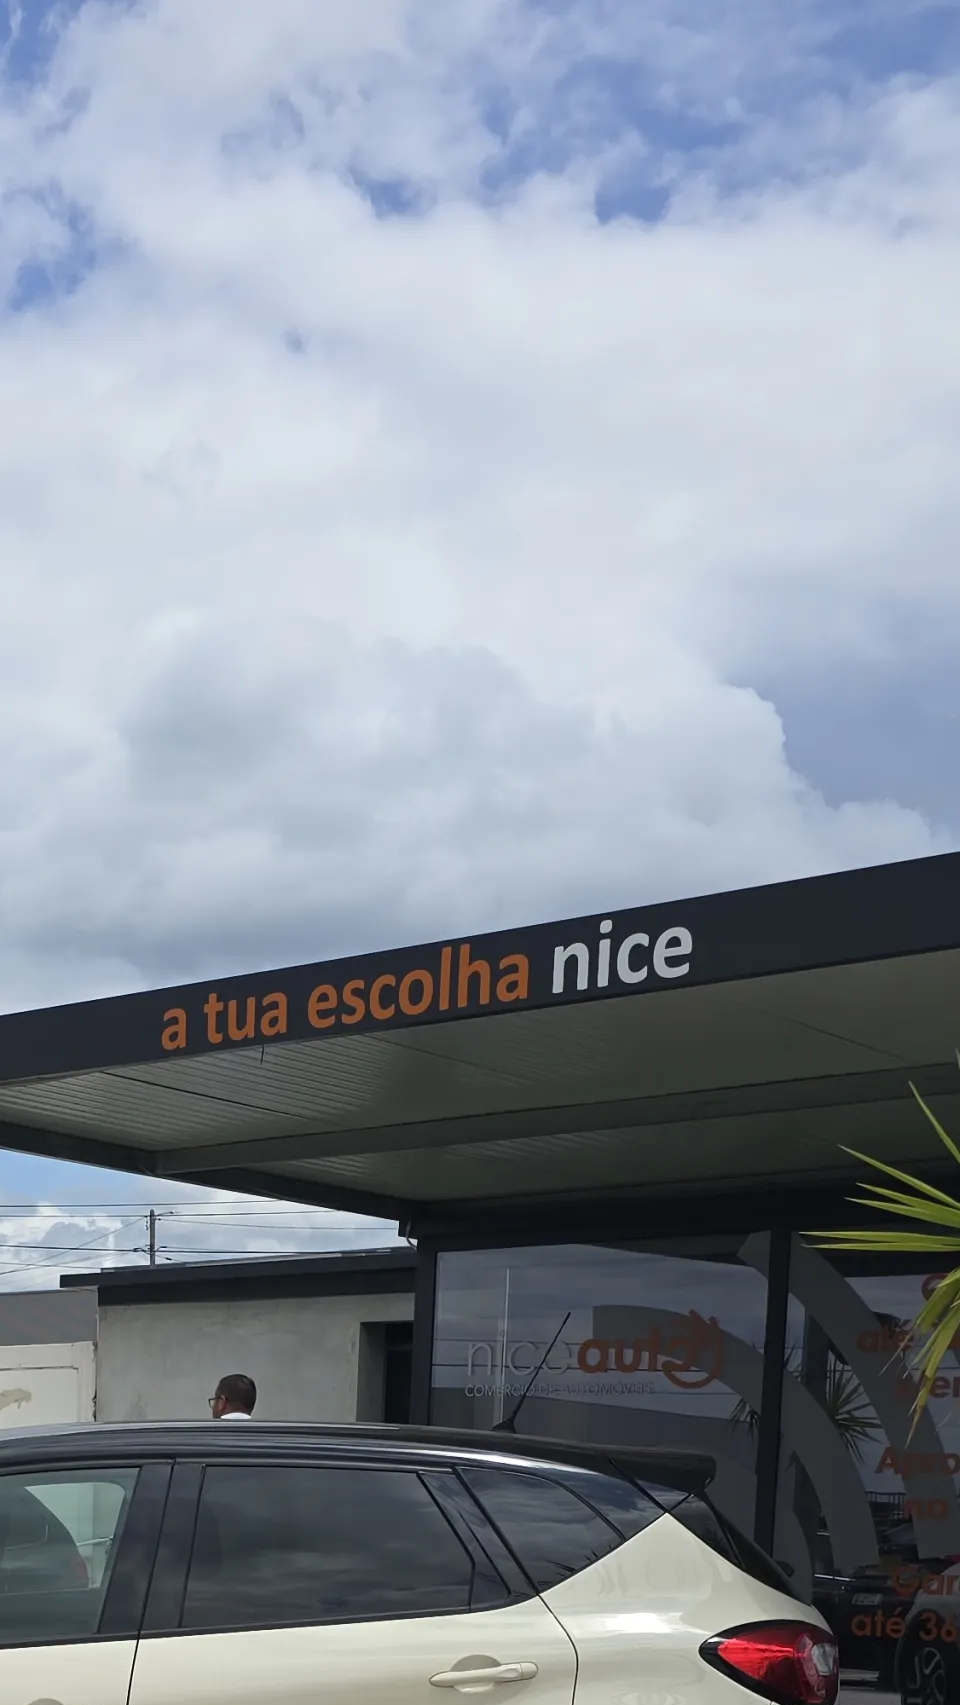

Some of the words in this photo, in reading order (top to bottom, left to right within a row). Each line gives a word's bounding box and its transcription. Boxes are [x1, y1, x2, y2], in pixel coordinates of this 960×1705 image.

[161, 1007, 187, 1050] a
[203, 991, 288, 1044] tua
[307, 943, 530, 1029] escolha
[551, 919, 693, 994] nice
[851, 1606, 907, 1639] até
[918, 1611, 958, 1643] 36
